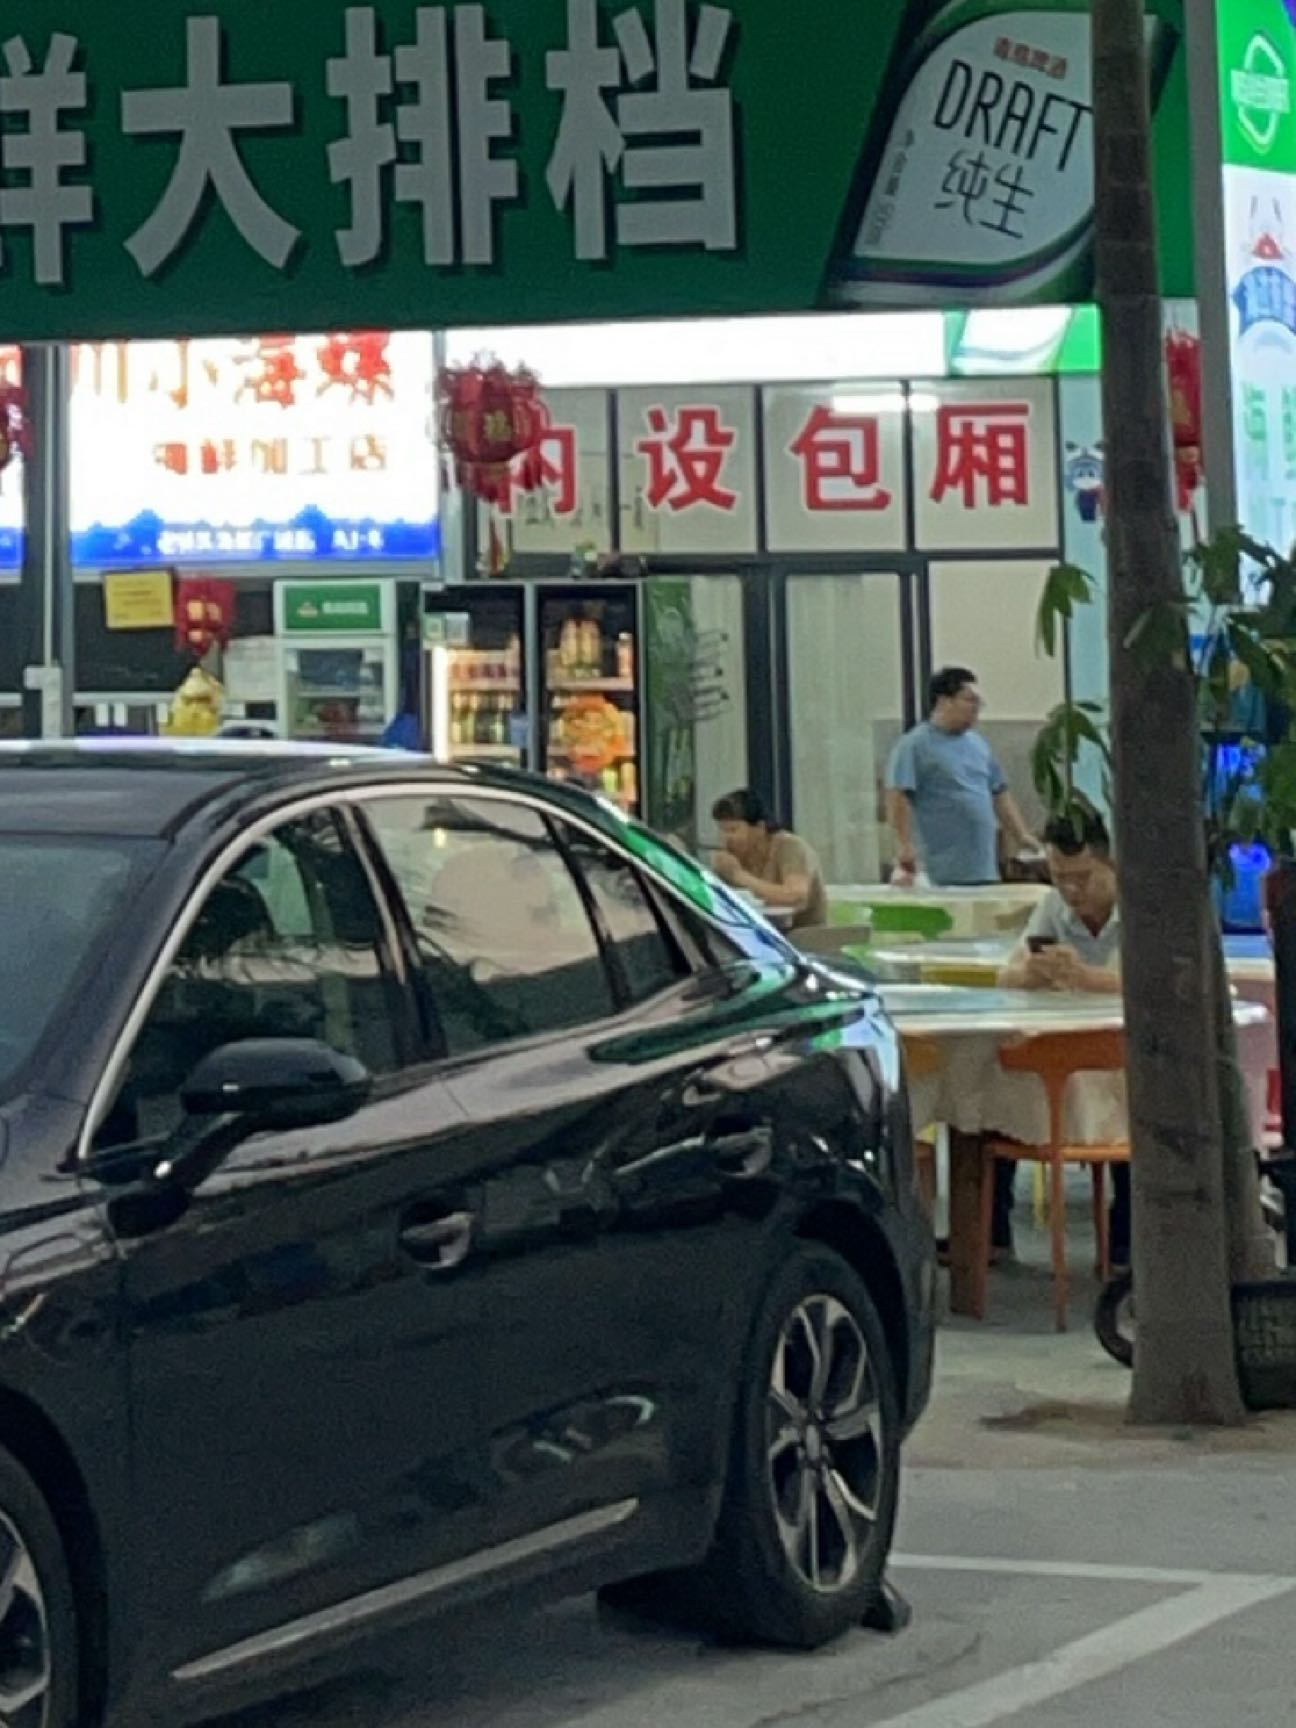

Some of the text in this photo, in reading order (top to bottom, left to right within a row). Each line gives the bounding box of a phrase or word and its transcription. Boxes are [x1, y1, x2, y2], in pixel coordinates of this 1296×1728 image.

[934, 58, 1094, 172] DRAFT
[934, 150, 1035, 239] 纯生
[496, 402, 1030, 514] 内设包厢
